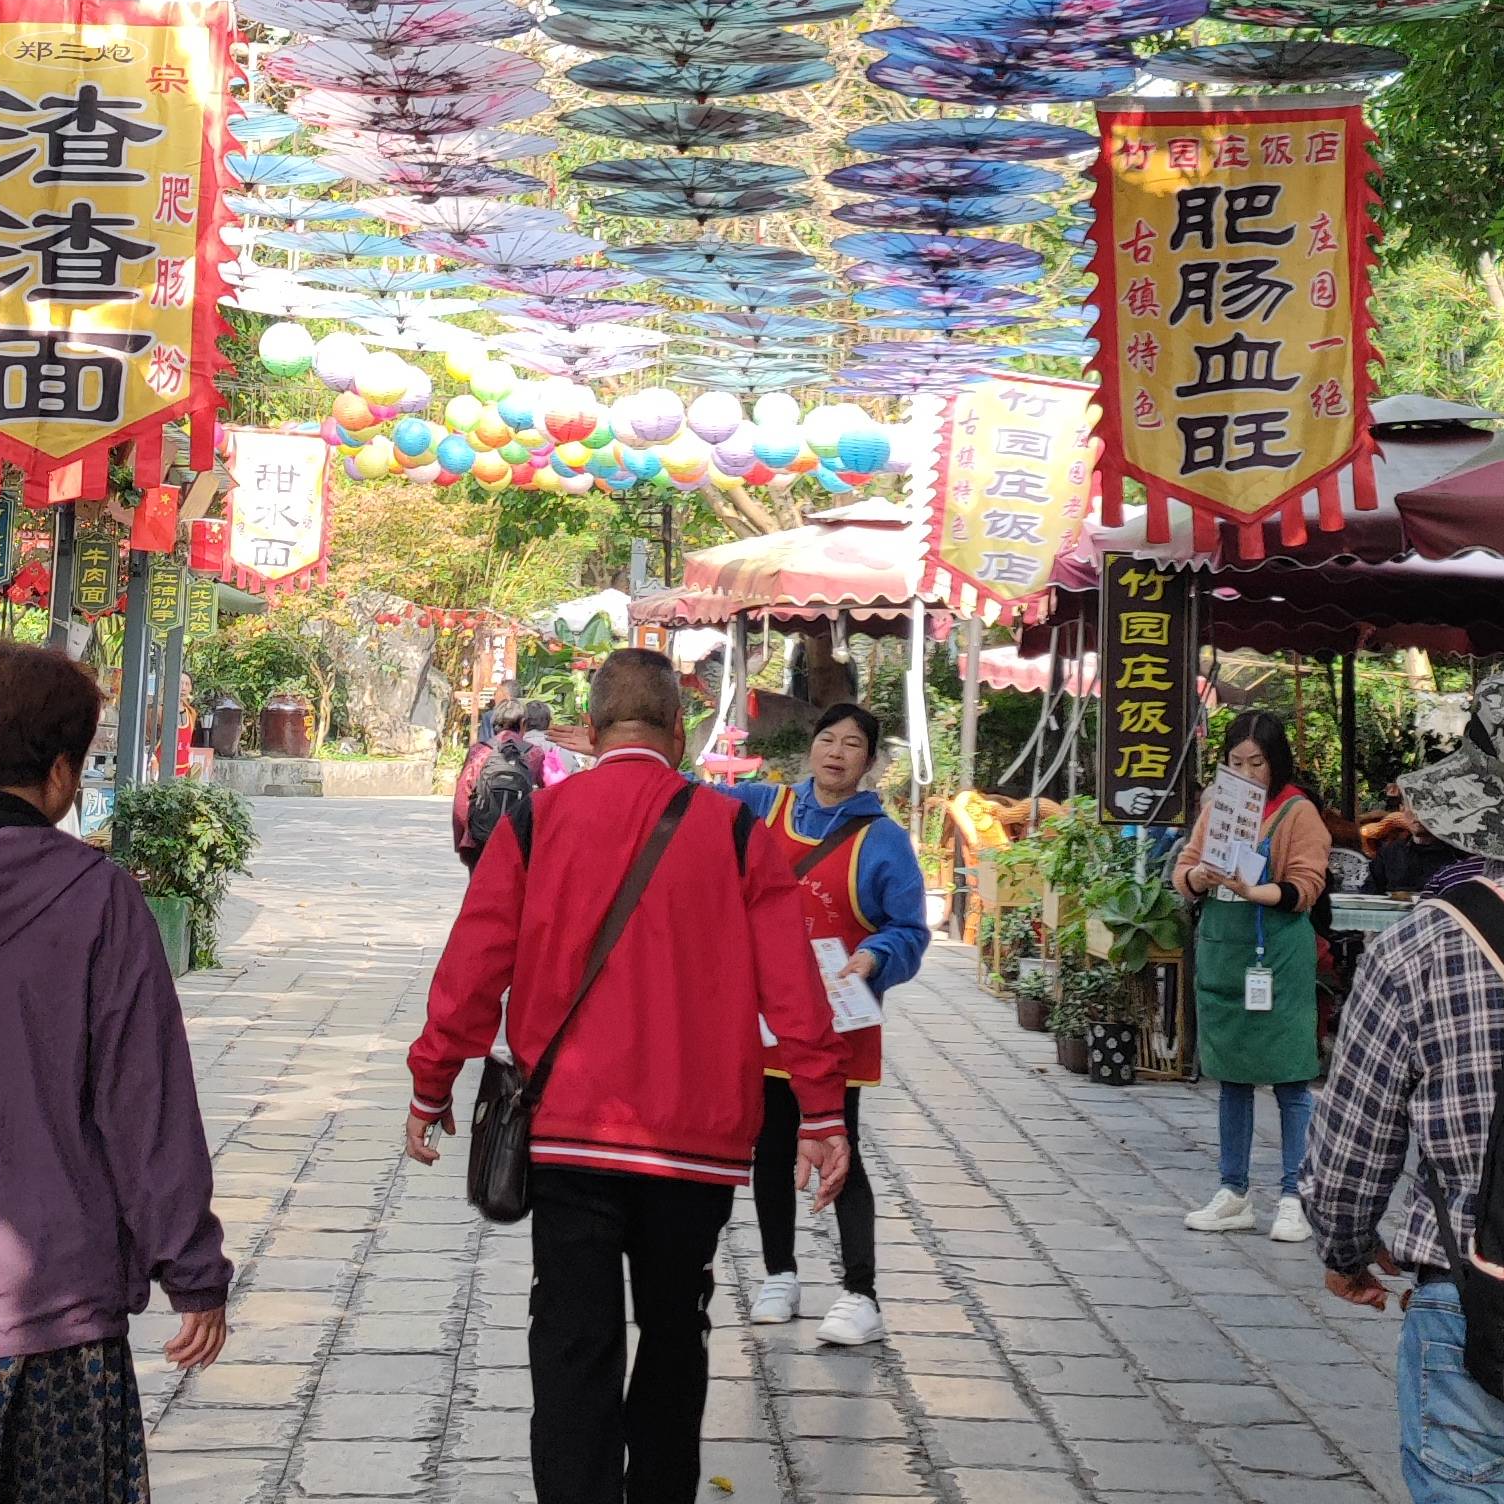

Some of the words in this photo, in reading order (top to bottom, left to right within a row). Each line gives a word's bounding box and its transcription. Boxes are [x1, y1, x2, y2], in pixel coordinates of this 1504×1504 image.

[13, 40, 136, 64] 郑三炮
[1119, 130, 1340, 171] 竹园庄饭店
[146, 172, 198, 396] 肥肠粉
[1118, 218, 1164, 432] 古镇特色
[1169, 184, 1303, 476] 肥肠血旺
[251, 464, 301, 568] 甜水面
[976, 387, 1060, 586] 竹园庄饭店
[81, 546, 109, 605] 牛肉面
[151, 571, 179, 622] 红油抄手
[1114, 566, 1176, 779] 竹园庄饭店
